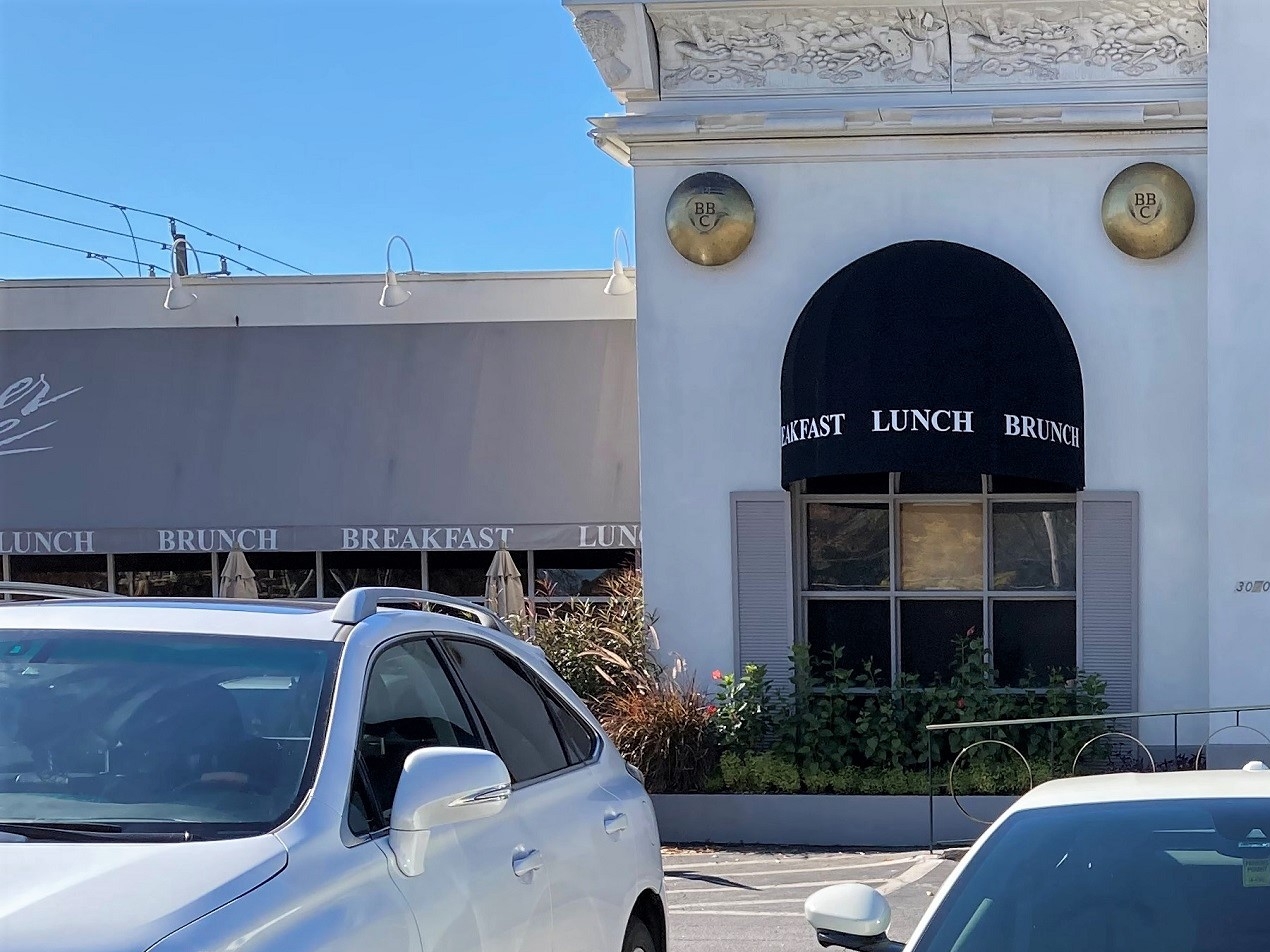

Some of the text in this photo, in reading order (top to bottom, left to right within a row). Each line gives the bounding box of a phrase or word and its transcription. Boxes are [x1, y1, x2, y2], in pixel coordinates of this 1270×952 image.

[1134, 192, 1156, 206] BB
[694, 201, 716, 215] BB
[1139, 205, 1151, 219] C
[699, 214, 711, 227] C
[871, 409, 974, 433] LUNCH
[1003, 413, 1080, 448] BRUNCH
[157, 528, 279, 552] BRUNCH
[341, 526, 514, 550] BREAKFAST
[577, 524, 642, 547] LUN
